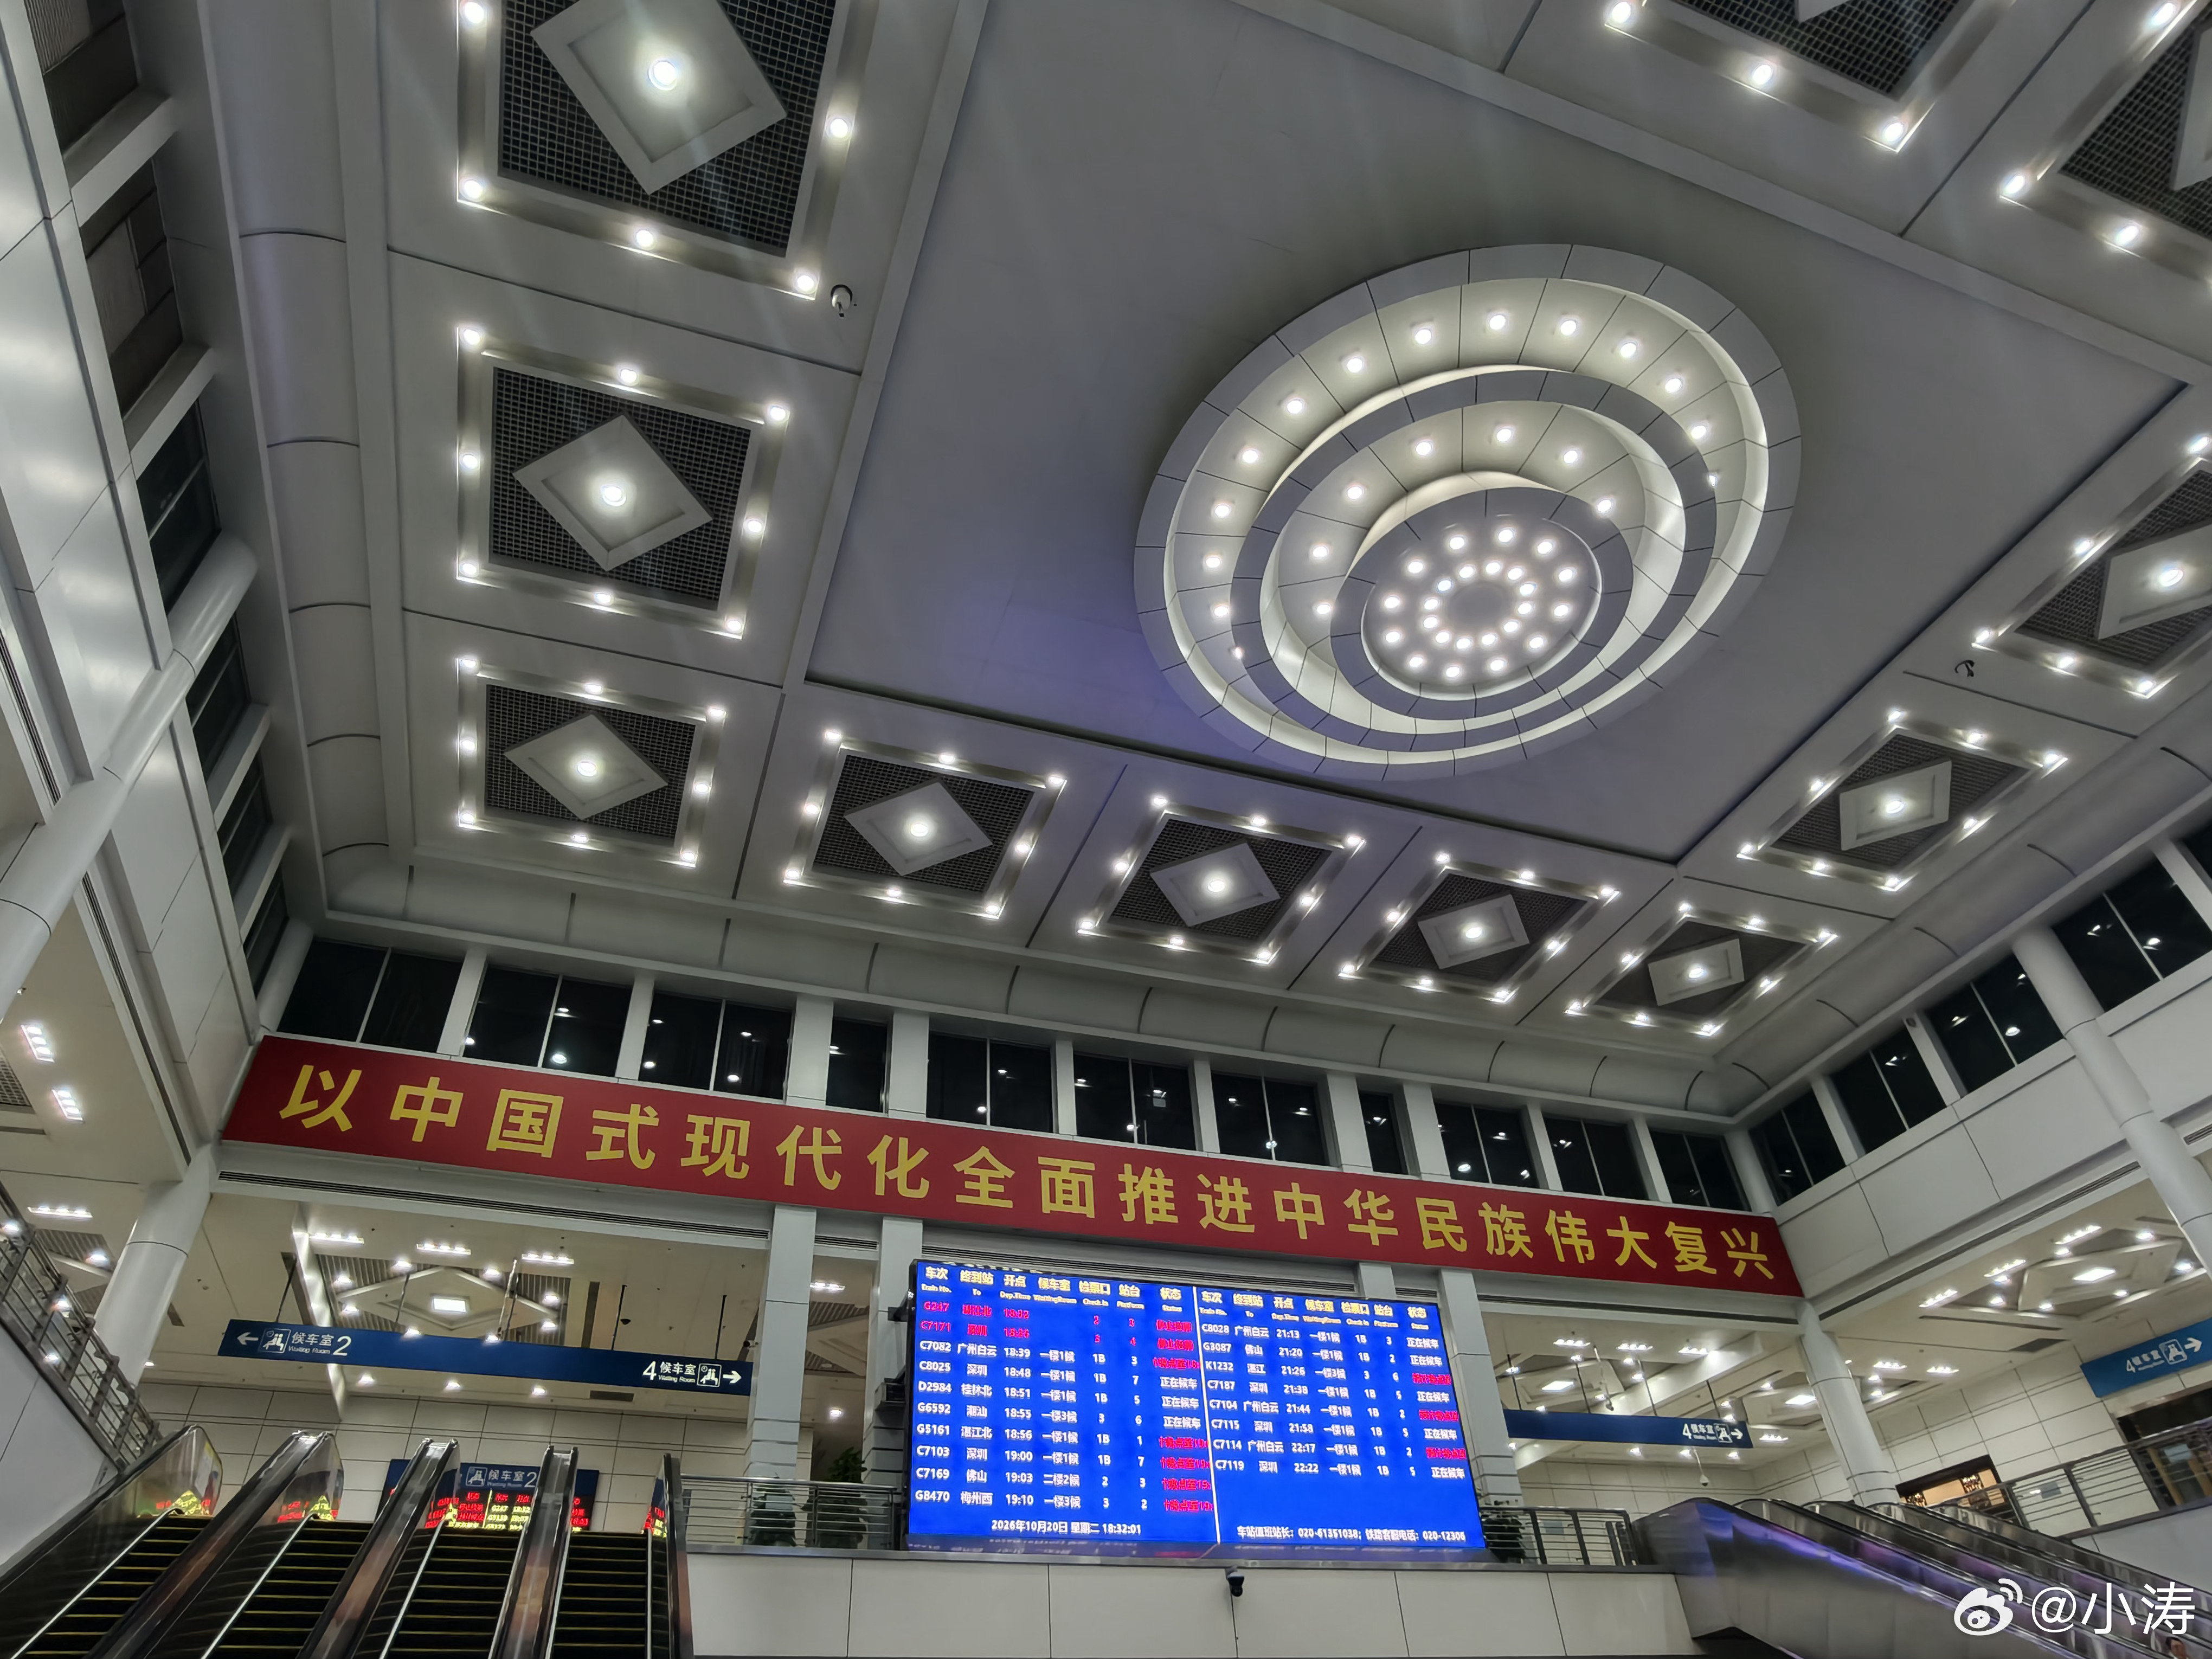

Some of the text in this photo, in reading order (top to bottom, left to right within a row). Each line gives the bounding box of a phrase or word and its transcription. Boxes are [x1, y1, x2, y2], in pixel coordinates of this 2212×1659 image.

[279, 1063, 1774, 1281] 以中国式现代化全面推进中华民族伟大复兴
[925, 1266, 948, 1279] 车次
[1004, 1275, 1026, 1287] 开点
[1038, 1277, 1070, 1291] 候车室
[1119, 1284, 1140, 1297] 站台
[924, 1301, 949, 1311] G247
[1274, 1297, 1294, 1309] 开点
[921, 1321, 951, 1332] C7171
[292, 1332, 351, 1356] 候车室 2
[1234, 1326, 1269, 1338] 广州白云
[1277, 1329, 1300, 1339] 21:13
[1355, 1335, 1366, 1343] 1B
[1386, 1336, 1392, 1345] 3
[1406, 1338, 1439, 1349] 正在候车
[920, 1341, 951, 1353] C7082
[957, 1343, 996, 1357] 广州白云
[1004, 1348, 1030, 1358] 18:39
[1093, 1354, 1105, 1364] 1B
[1131, 1356, 1137, 1366] 3
[1279, 1347, 1302, 1358] 21:20
[1359, 1353, 1369, 1361] 1B
[1390, 1354, 1395, 1362] 2
[1410, 1355, 1442, 1366] 正在候车
[642, 1361, 697, 1380] 4 候车室
[1205, 1361, 1233, 1372] K1232
[1282, 1366, 1305, 1376] 21:26
[1364, 1371, 1369, 1379] 3
[1393, 1372, 1399, 1381] 6
[2126, 1360, 2136, 1373] 4
[967, 1364, 987, 1376] 深圳
[1004, 1367, 1031, 1378] 18:48
[1094, 1373, 1106, 1384] 1B
[1133, 1375, 1139, 1385] 7
[1160, 1377, 1197, 1390] 正在候车
[918, 1381, 952, 1392] D2984
[1005, 1387, 1030, 1399] 18:51
[1095, 1393, 1108, 1403] 1B
[1134, 1396, 1140, 1404] 5
[1162, 1396, 1199, 1410] 正在候车
[1207, 1380, 1235, 1390] C7187
[1249, 1382, 1268, 1393] 深圳
[1284, 1385, 1308, 1394] 21:38
[1365, 1389, 1376, 1399] 1B
[1417, 1391, 1450, 1403] 正在候车
[1210, 1399, 1237, 1410] C7104
[1244, 1400, 1278, 1413] 广州白云
[1287, 1404, 1310, 1413] 21:44
[1367, 1408, 1379, 1417] 1B
[1005, 1408, 1031, 1419] 18:55
[1041, 1410, 1077, 1423] 一楼3候
[1099, 1413, 1104, 1423] 3
[1135, 1416, 1142, 1424] 6
[1163, 1416, 1201, 1429] 正在候车
[917, 1424, 949, 1435] G5161
[1005, 1429, 1032, 1441] 18:56
[1043, 1431, 1078, 1444] 一楼1候
[1097, 1434, 1110, 1444] 1B
[1137, 1436, 1142, 1445] 1
[1211, 1419, 1239, 1430] C7115
[1254, 1421, 1272, 1433] 深圳
[1371, 1427, 1382, 1436] 1B
[1424, 1429, 1457, 1440] 正在候车
[1682, 1423, 1692, 1439] 4
[917, 1445, 950, 1457] C7103
[967, 1448, 987, 1461] 深圳
[1005, 1451, 1033, 1462] 19:00
[1098, 1455, 1110, 1465] 1B
[1138, 1456, 1144, 1467] 7
[1213, 1439, 1242, 1450] C7114
[1248, 1440, 1284, 1453] 广州白云
[1292, 1443, 1315, 1453] 22:17
[1374, 1446, 1385, 1455] 1B
[524, 1471, 537, 1488] 2
[916, 1468, 1146, 1488] C7169 佛山 19:03 二楼2候 2 3
[1216, 1460, 1244, 1470] C7119
[1259, 1461, 1277, 1472] 深圳
[1294, 1463, 1319, 1473] 22:22
[1377, 1466, 1389, 1475] 1B
[1431, 1467, 1465, 1479] 正在候车
[915, 1490, 1147, 1509] G8470 梅州西 19:10 一楼3候 3 2
[992, 1520, 1068, 1534] 2026年10月20日
[1102, 1523, 1141, 1535] 18:32:01
